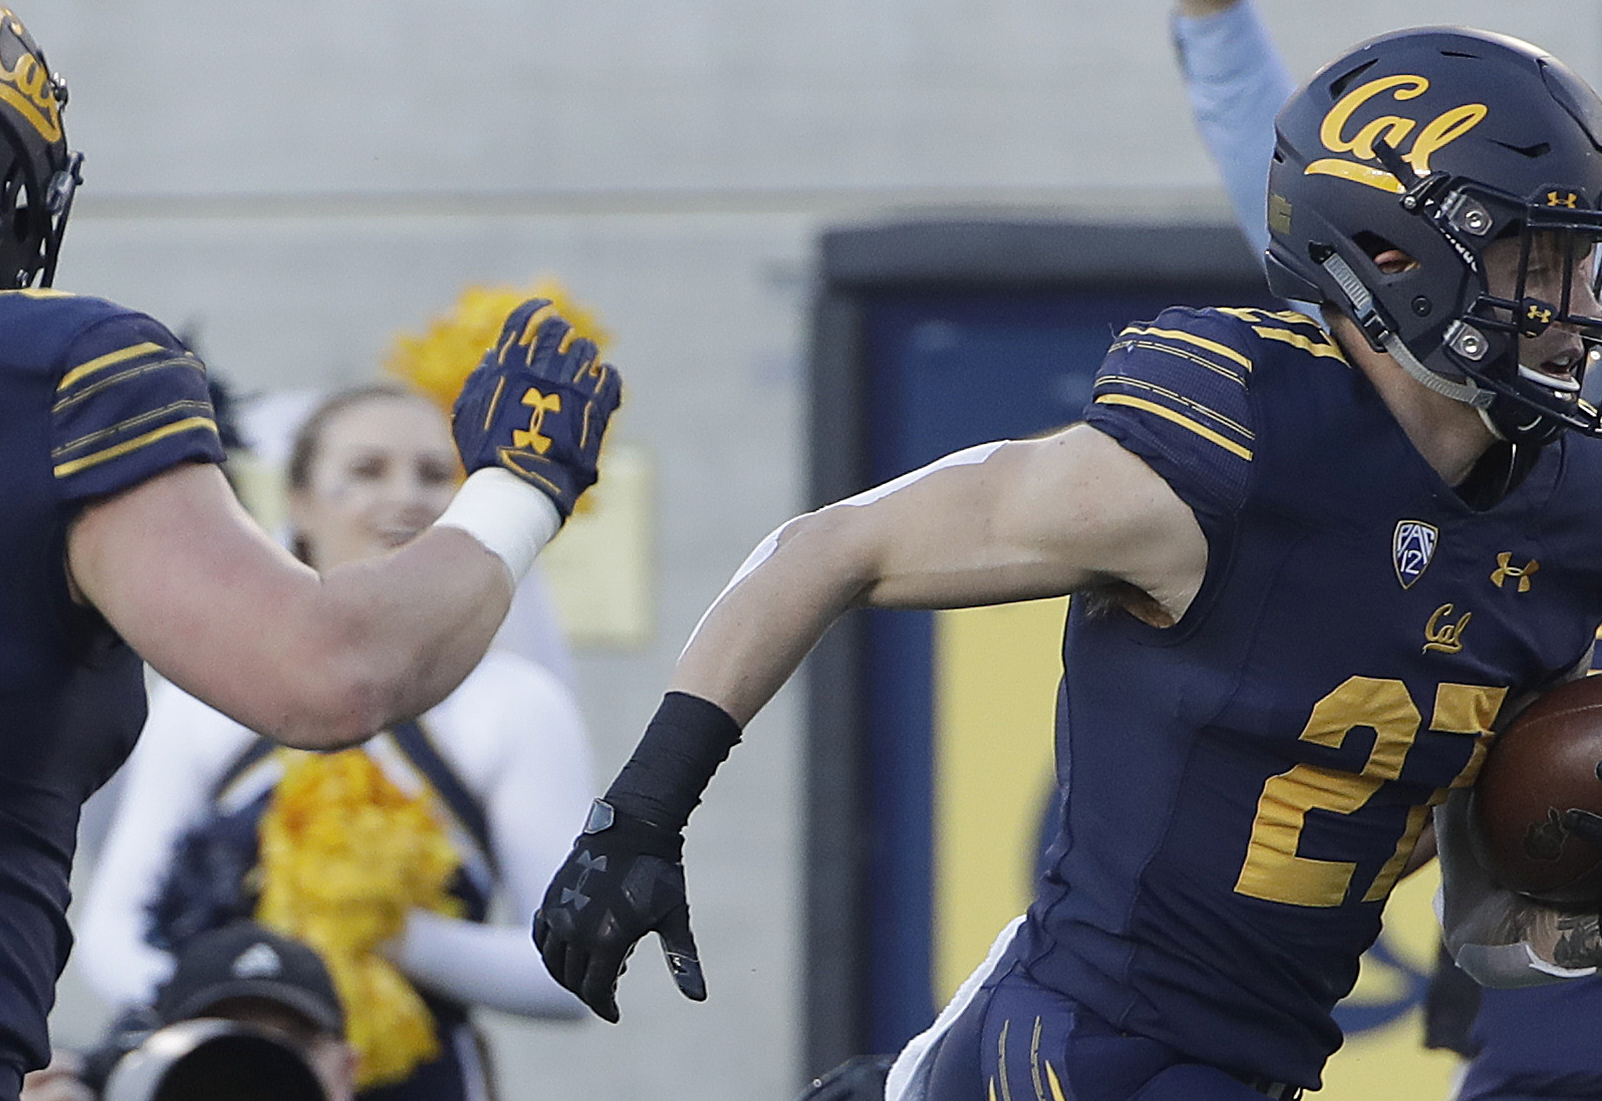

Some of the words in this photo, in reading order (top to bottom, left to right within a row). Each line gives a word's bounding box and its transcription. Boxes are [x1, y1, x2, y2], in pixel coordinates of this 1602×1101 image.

[1304, 74, 1488, 194] Cal
[1397, 523, 1436, 566] PAC
[1400, 549, 1424, 576] 12
[1421, 602, 1472, 655] Cal
[1233, 674, 1510, 908] 27
